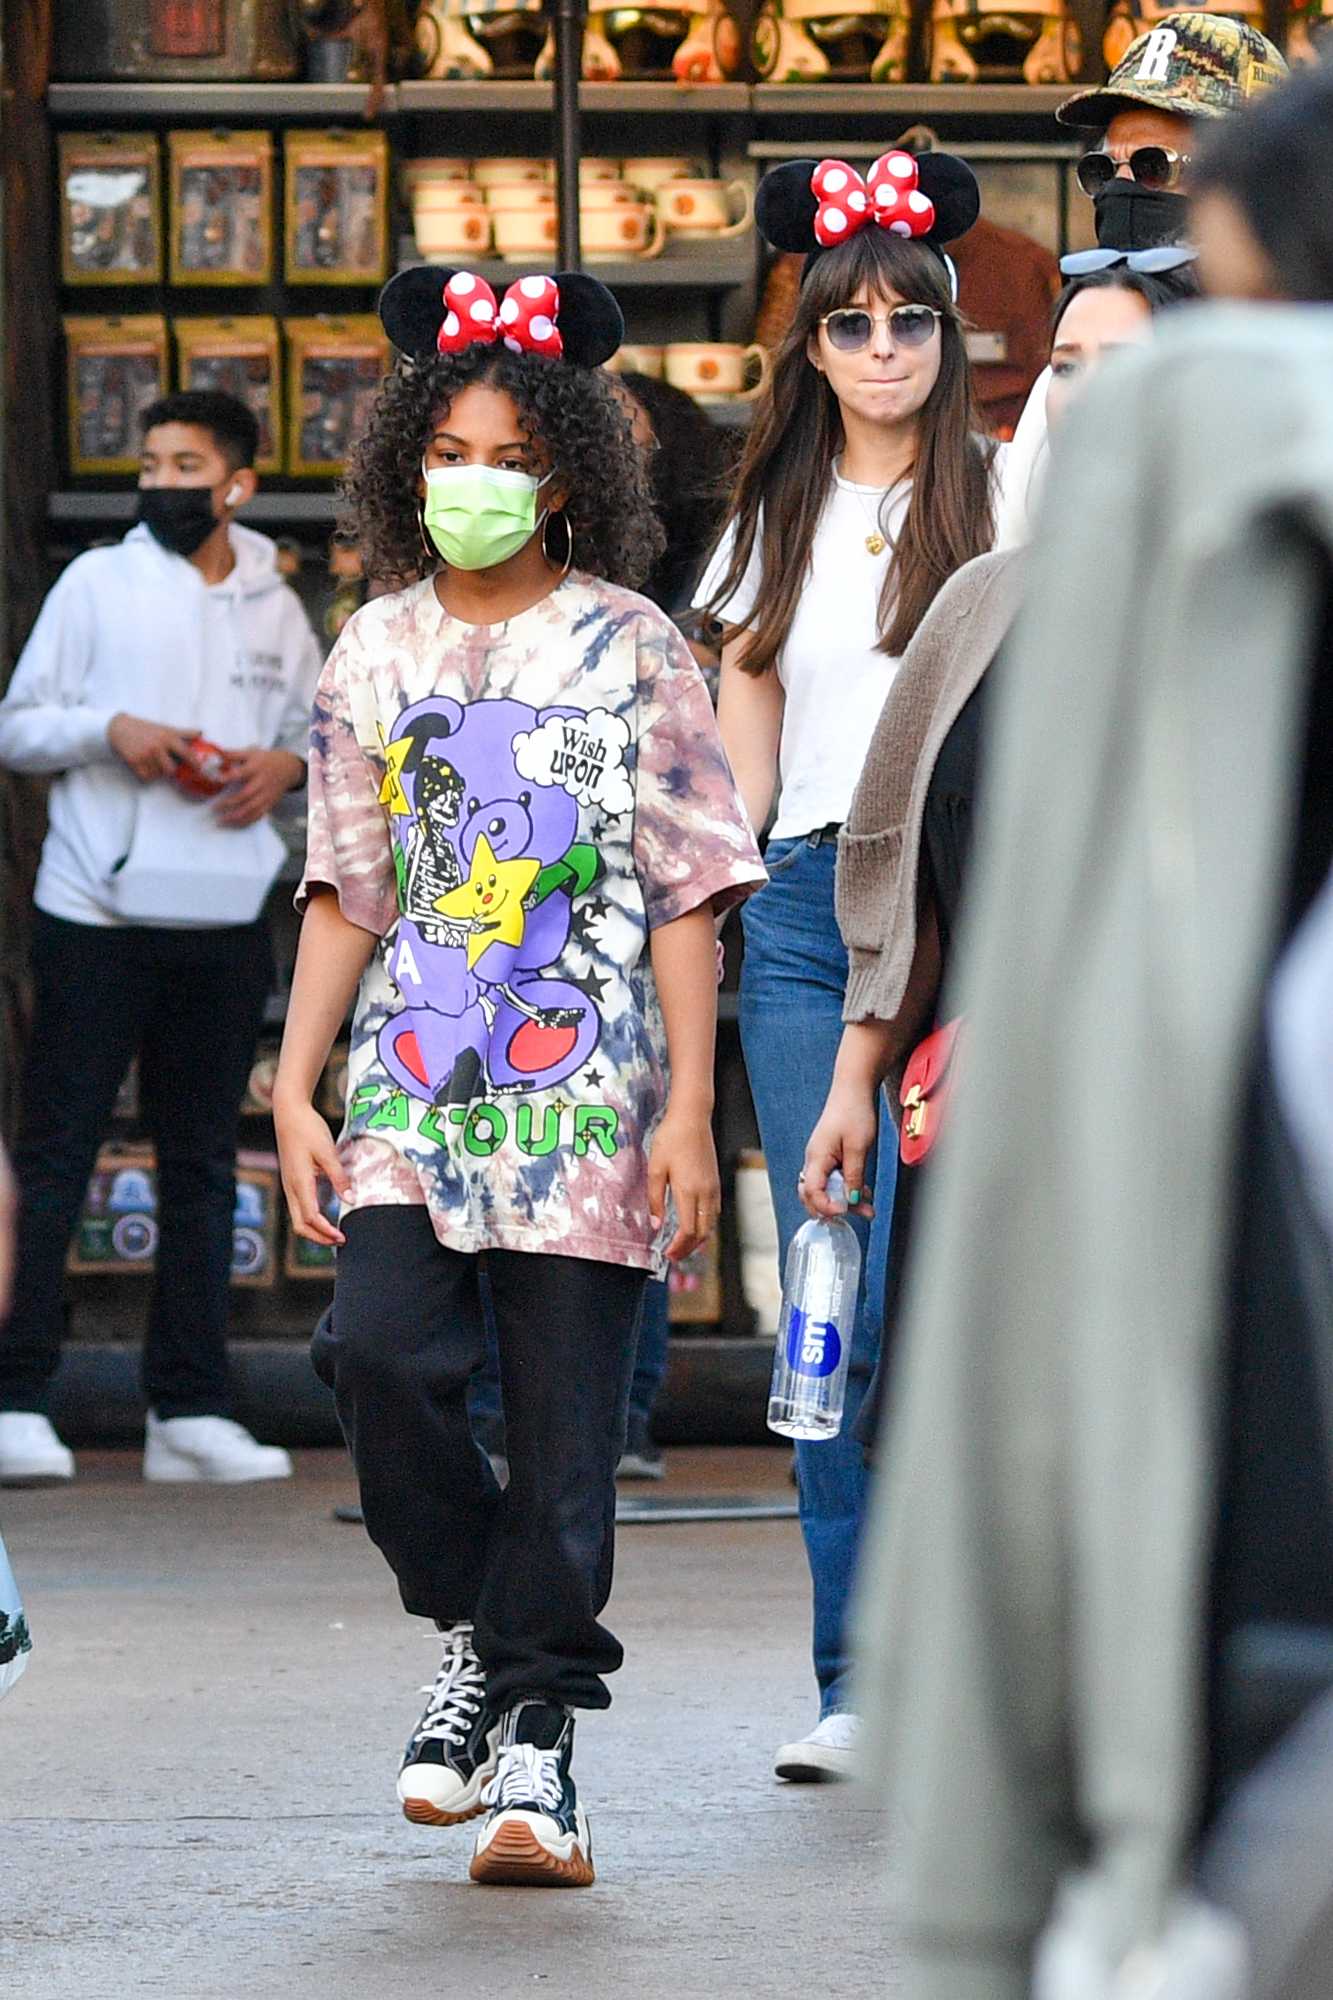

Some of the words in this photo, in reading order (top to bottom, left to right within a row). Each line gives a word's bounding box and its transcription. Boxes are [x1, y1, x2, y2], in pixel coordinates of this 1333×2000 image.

[1133, 28, 1177, 81] R
[562, 726, 607, 763] Wish
[395, 939, 423, 985] A
